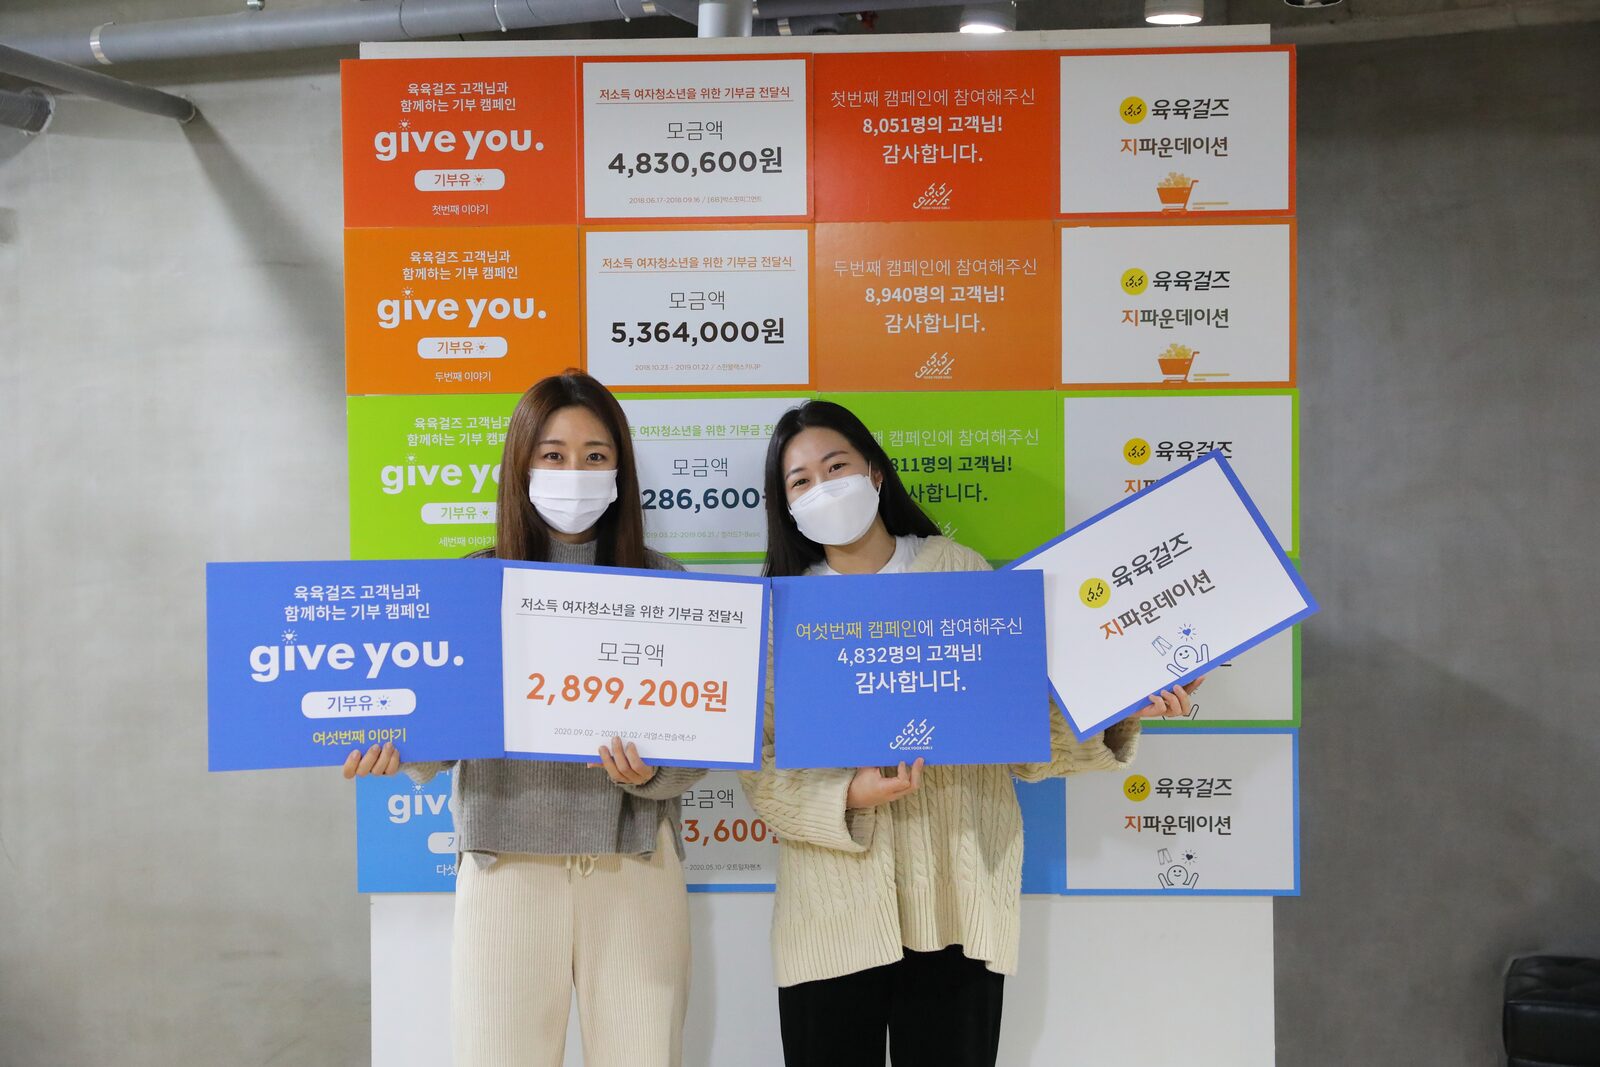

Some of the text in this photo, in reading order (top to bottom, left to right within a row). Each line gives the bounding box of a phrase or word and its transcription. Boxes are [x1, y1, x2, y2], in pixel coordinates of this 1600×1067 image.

[407, 81, 509, 96] 육육걸즈 고객님과
[600, 86, 790, 101] 저소득 여자청소년을 위한 기부금 전달식
[830, 87, 1036, 108] 첫번째 캠페인에 참여해주신
[400, 97, 517, 113] 함께하는 기부 캠페인
[1151, 98, 1230, 120] 육육걸즈
[667, 120, 723, 141] 모금액
[863, 115, 1003, 137] 8,051명의 고객님!
[374, 120, 545, 162] give you.
[1120, 136, 1229, 158] 지파운데이션
[607, 146, 783, 178] 4,830,600원
[882, 143, 984, 165] 감사합니다.
[434, 173, 471, 187] 기부유
[431, 203, 489, 216] 첫번째 이야기
[409, 250, 511, 264] 육육걸즈 고객님과
[602, 255, 792, 270] 저소득 여자청소년을 위한 기부금 전달식
[832, 257, 1038, 278] 두번째 캠페인에 참여해주신
[402, 266, 519, 281] 함께하는 기부 캠페인
[1152, 270, 1231, 291] 육육걸즈
[669, 290, 725, 311] 모금액
[865, 285, 1005, 306] 8,940명의 고객님!
[376, 287, 547, 329] give you.
[1121, 308, 1229, 329] 지파운데이션
[611, 317, 785, 347] 5,364,000원
[884, 312, 986, 334] 감사합니다.
[437, 341, 474, 355] 기부유
[434, 371, 491, 383] 두번째 이야기
[414, 417, 463, 430] 육육걸즈
[639, 425, 702, 437] 여자청소년을
[705, 424, 726, 437] 위한
[729, 424, 760, 436] 기부금
[407, 433, 456, 447] 함께하는
[458, 432, 483, 446] 기부
[888, 429, 953, 447] 캠페인에
[958, 428, 1040, 447] 참여해주신
[380, 453, 463, 495] give
[671, 457, 728, 478] 모금액
[891, 455, 1013, 474] 811명의 고객님!
[641, 487, 766, 514] 286,600
[909, 482, 989, 503] 사합니다.
[440, 506, 477, 520] 기부유
[438, 535, 495, 548] 세번째 이야기
[1111, 532, 1193, 589] 육육걸즈
[293, 583, 421, 602] 육육걸즈 고객님과
[284, 602, 431, 623] 함께하는 기부 캠페인
[520, 597, 744, 625] 저소득 여자청소년을 위한 기부금 전달식
[1099, 569, 1216, 640] 지파운데이션
[795, 616, 1024, 641] 여섯번째 캠페인에 참여해주신
[249, 630, 464, 683] give you.
[597, 641, 665, 668] 모금액
[837, 643, 983, 668] 4,832명의 고객님!
[526, 672, 728, 713] 2,899,200원
[854, 669, 968, 695] 감사합니다.
[327, 695, 374, 713] 기부유
[312, 727, 407, 747] 여섯번째 이야기
[553, 727, 594, 737] 2020.09.02
[1154, 777, 1233, 799] 육육걸즈
[387, 784, 452, 824] giv
[1124, 815, 1232, 836] 지파운데이션
[435, 863, 457, 877] 다섯
